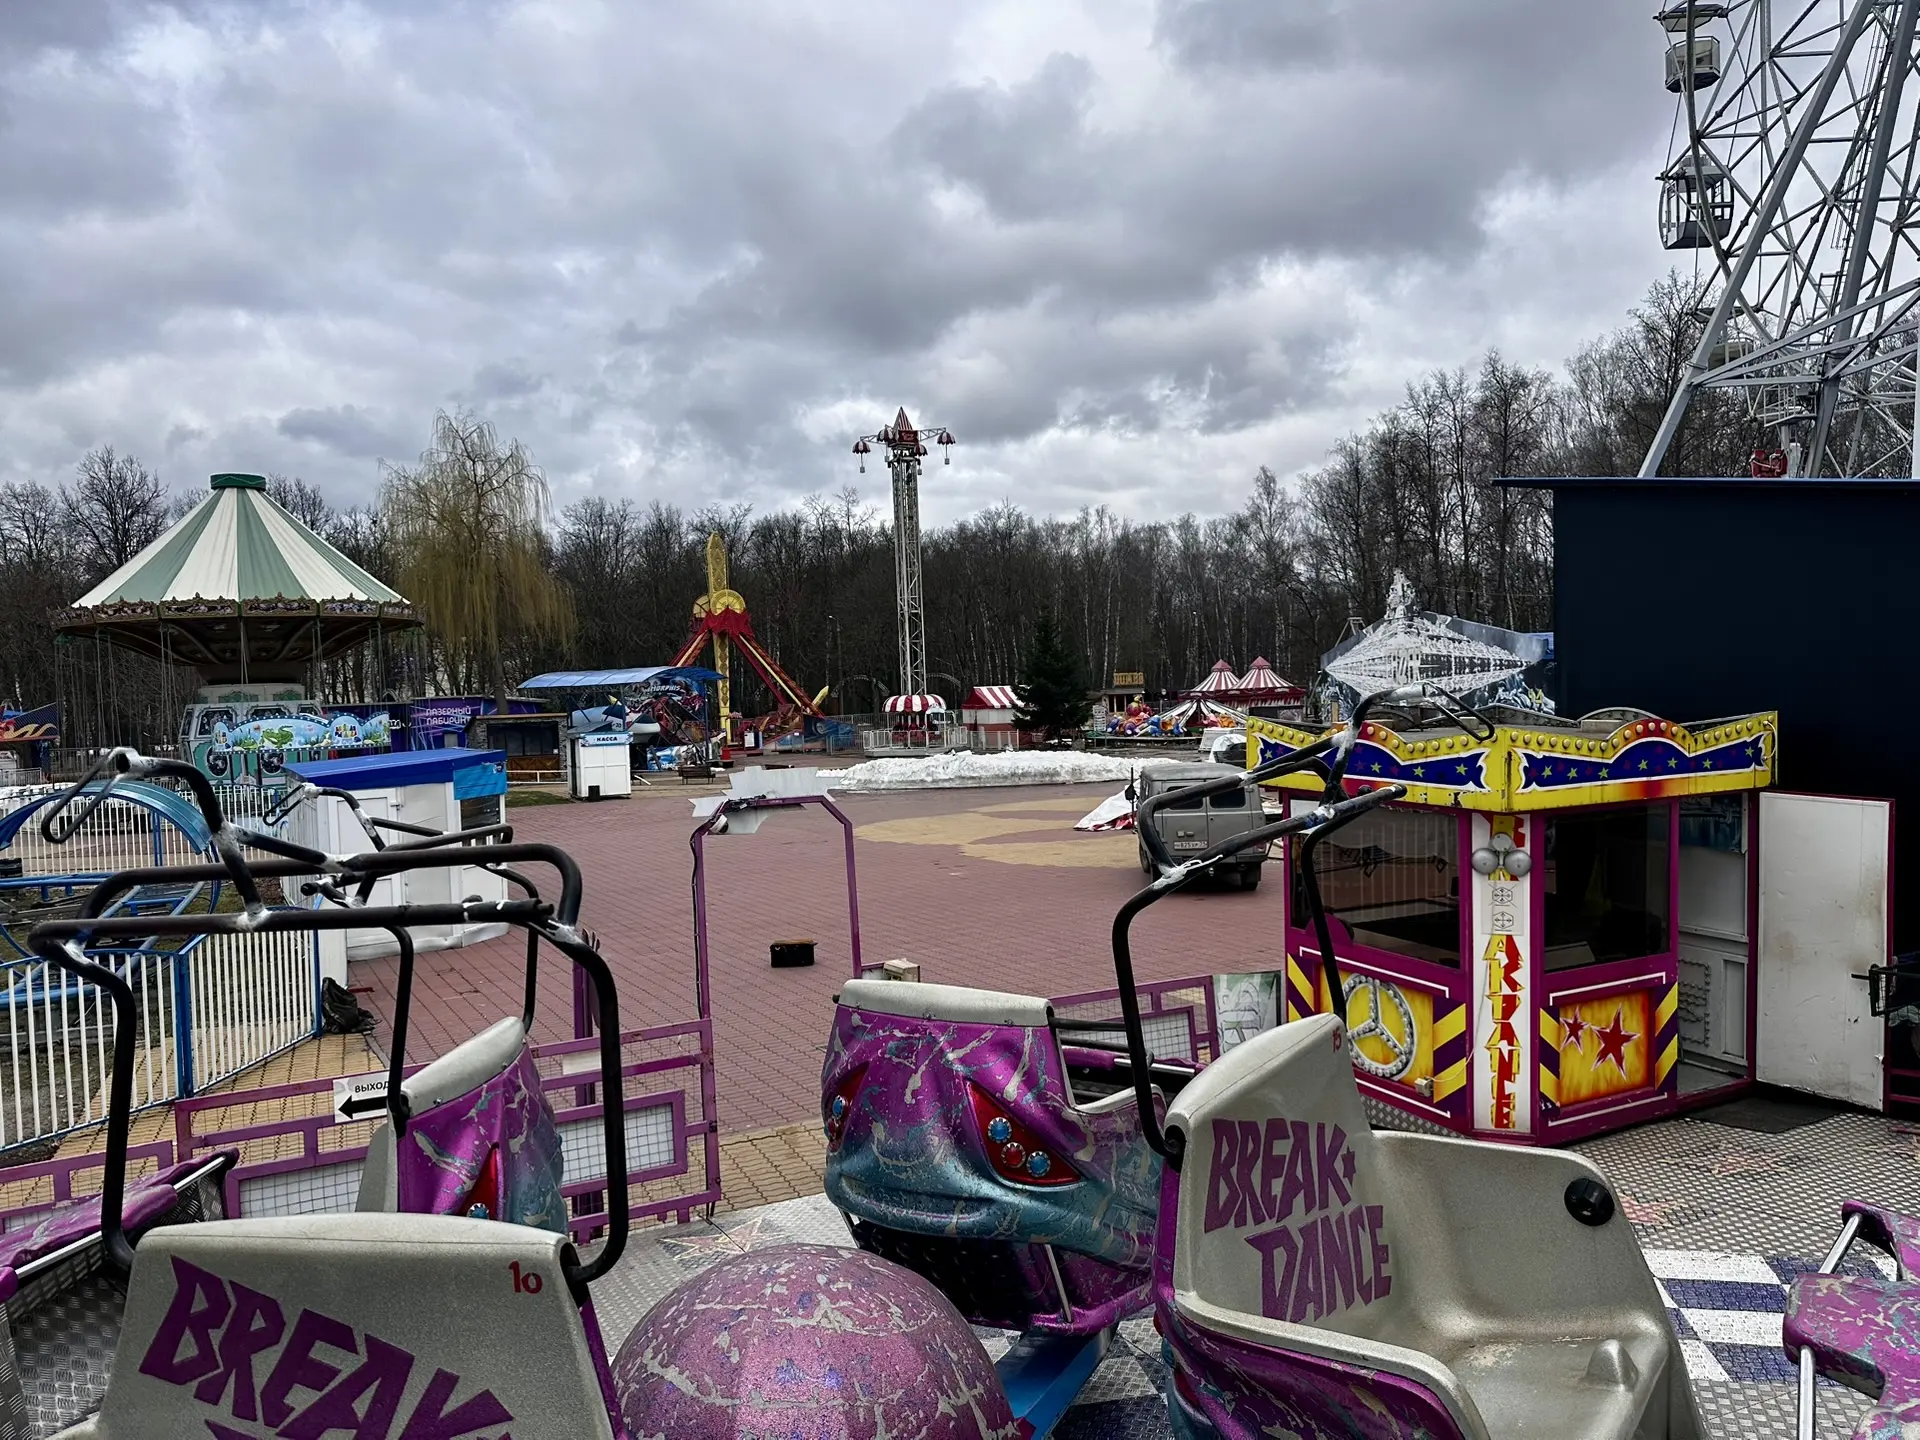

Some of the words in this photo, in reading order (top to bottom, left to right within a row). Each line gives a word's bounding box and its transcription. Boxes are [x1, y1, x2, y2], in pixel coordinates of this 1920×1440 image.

[426, 705, 472, 716] ЛАЗЕРНЫЙ
[1204, 1118, 1352, 1234] BREAK
[508, 1260, 543, 1294] 10
[1244, 1204, 1392, 1323] DANCE
